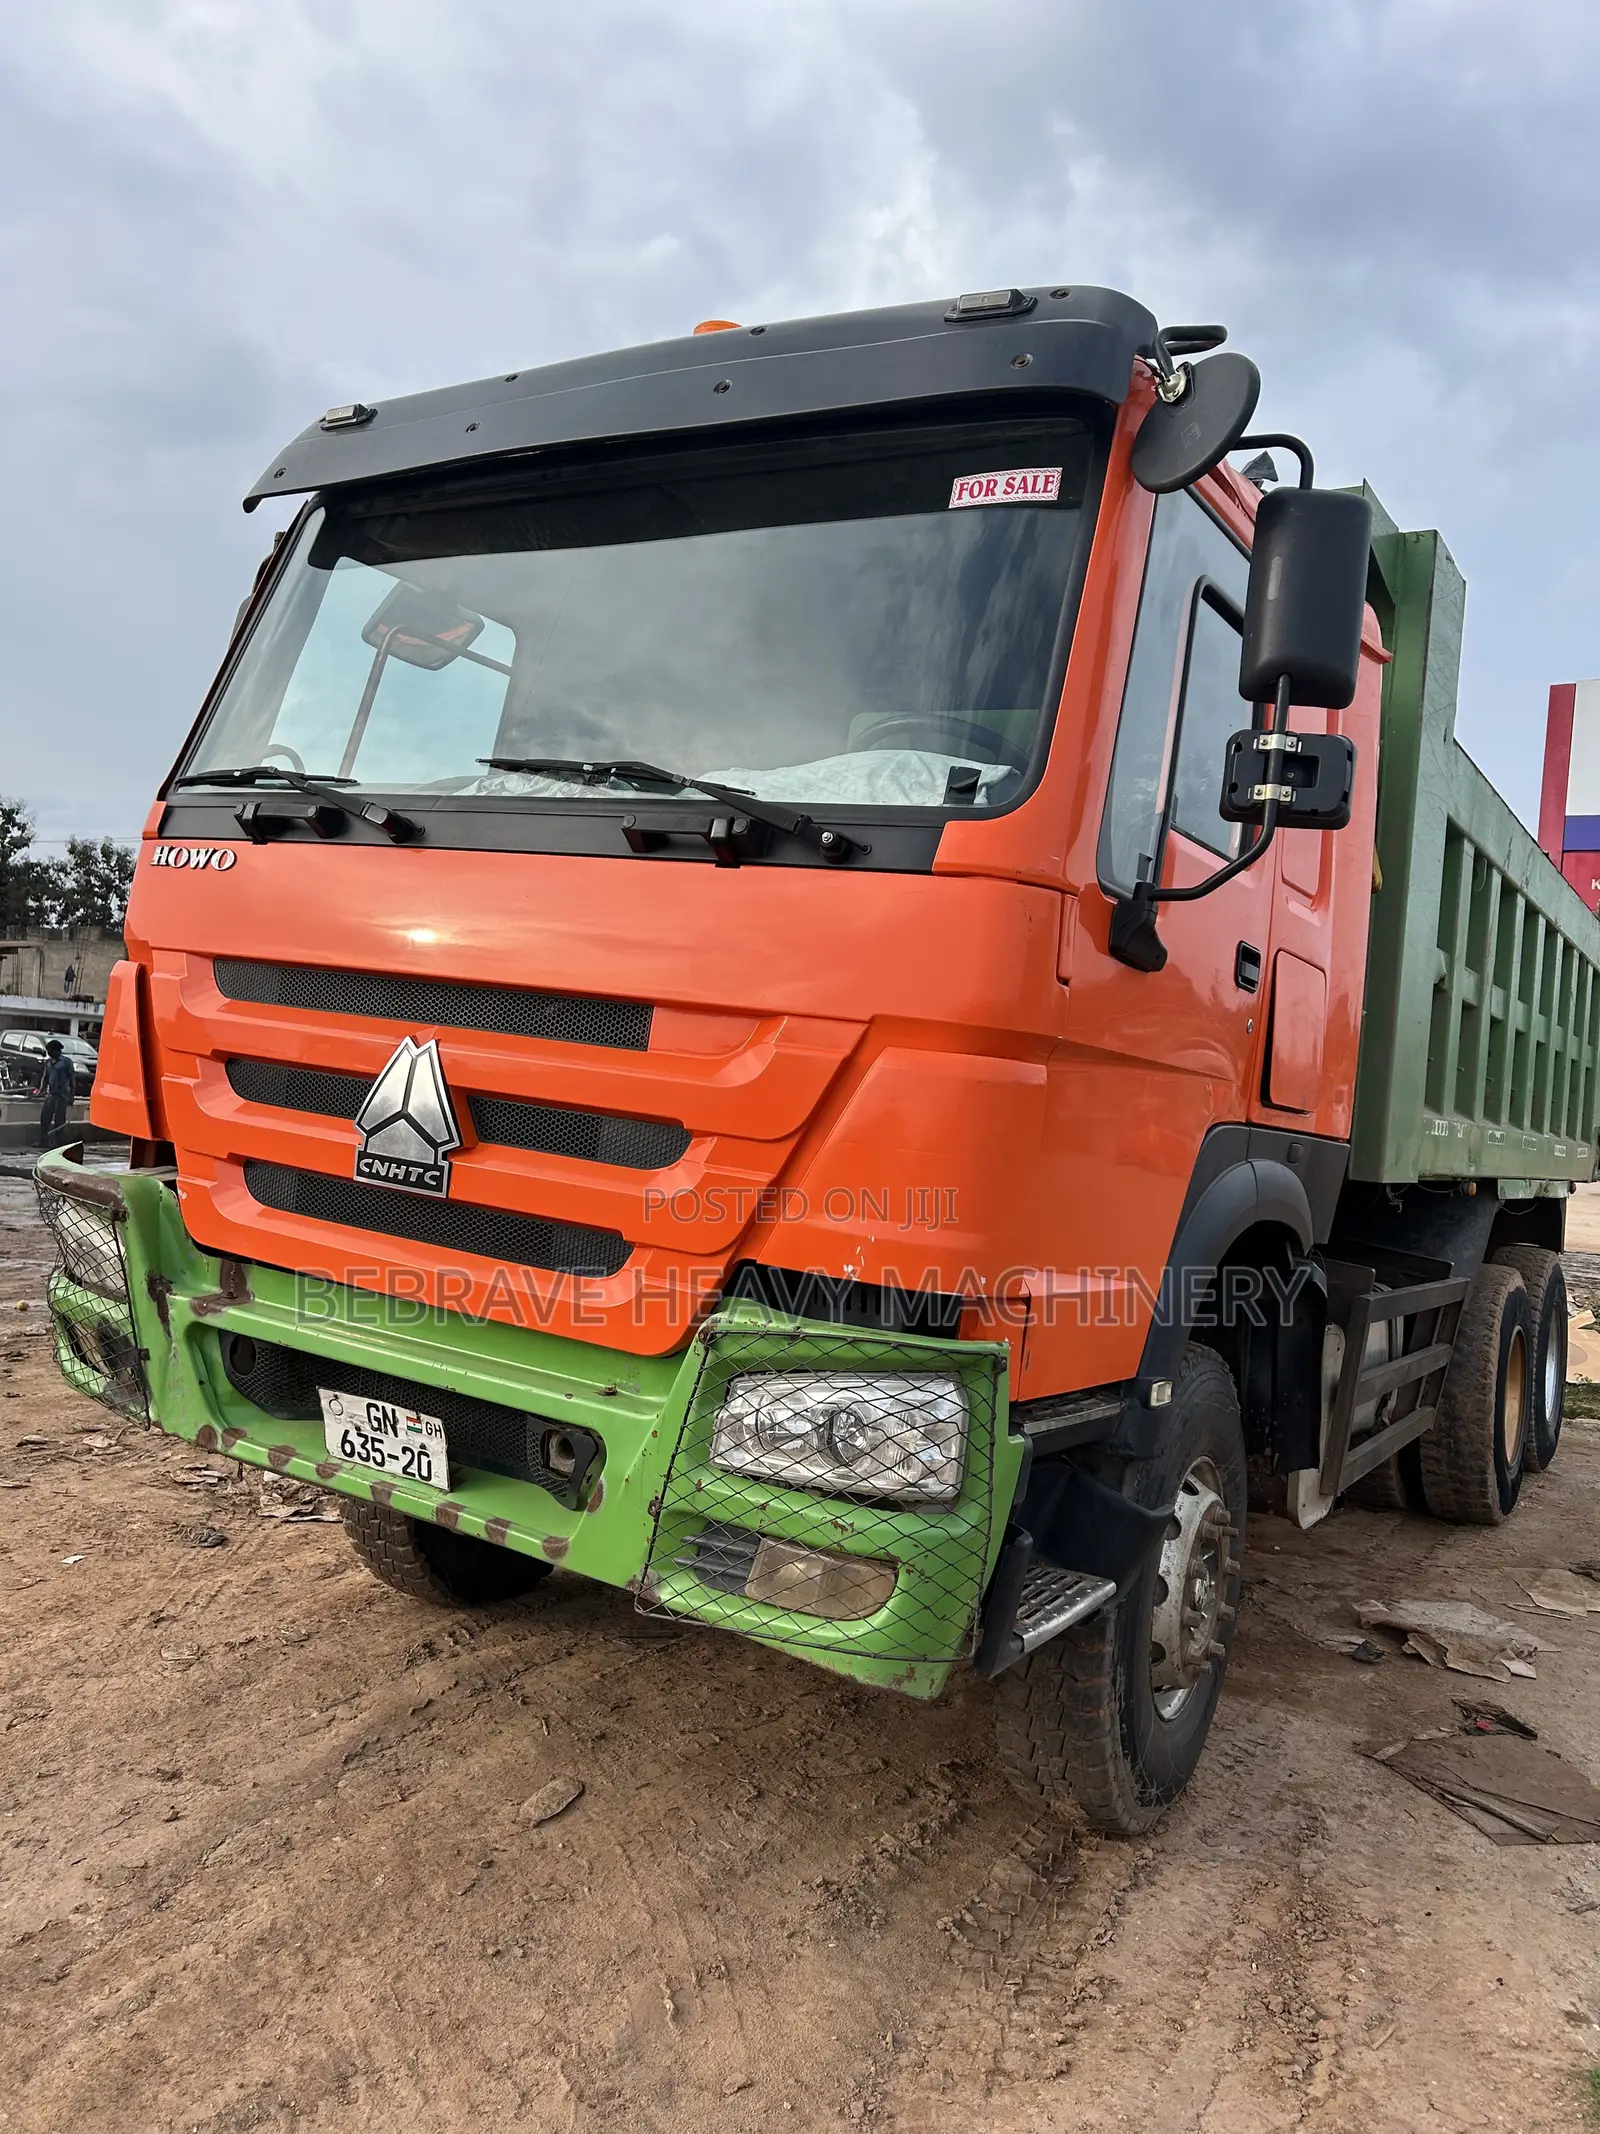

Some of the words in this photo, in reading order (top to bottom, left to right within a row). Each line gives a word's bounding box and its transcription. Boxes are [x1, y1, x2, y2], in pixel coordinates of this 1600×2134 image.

[956, 479, 998, 500] FOR
[1003, 475, 1055, 495] SALE
[150, 845, 237, 871] HOWO
[359, 1158, 441, 1186] CNHTC
[366, 1402, 398, 1438] GN
[425, 1421, 443, 1439] GH
[341, 1429, 432, 1482] 635-20
